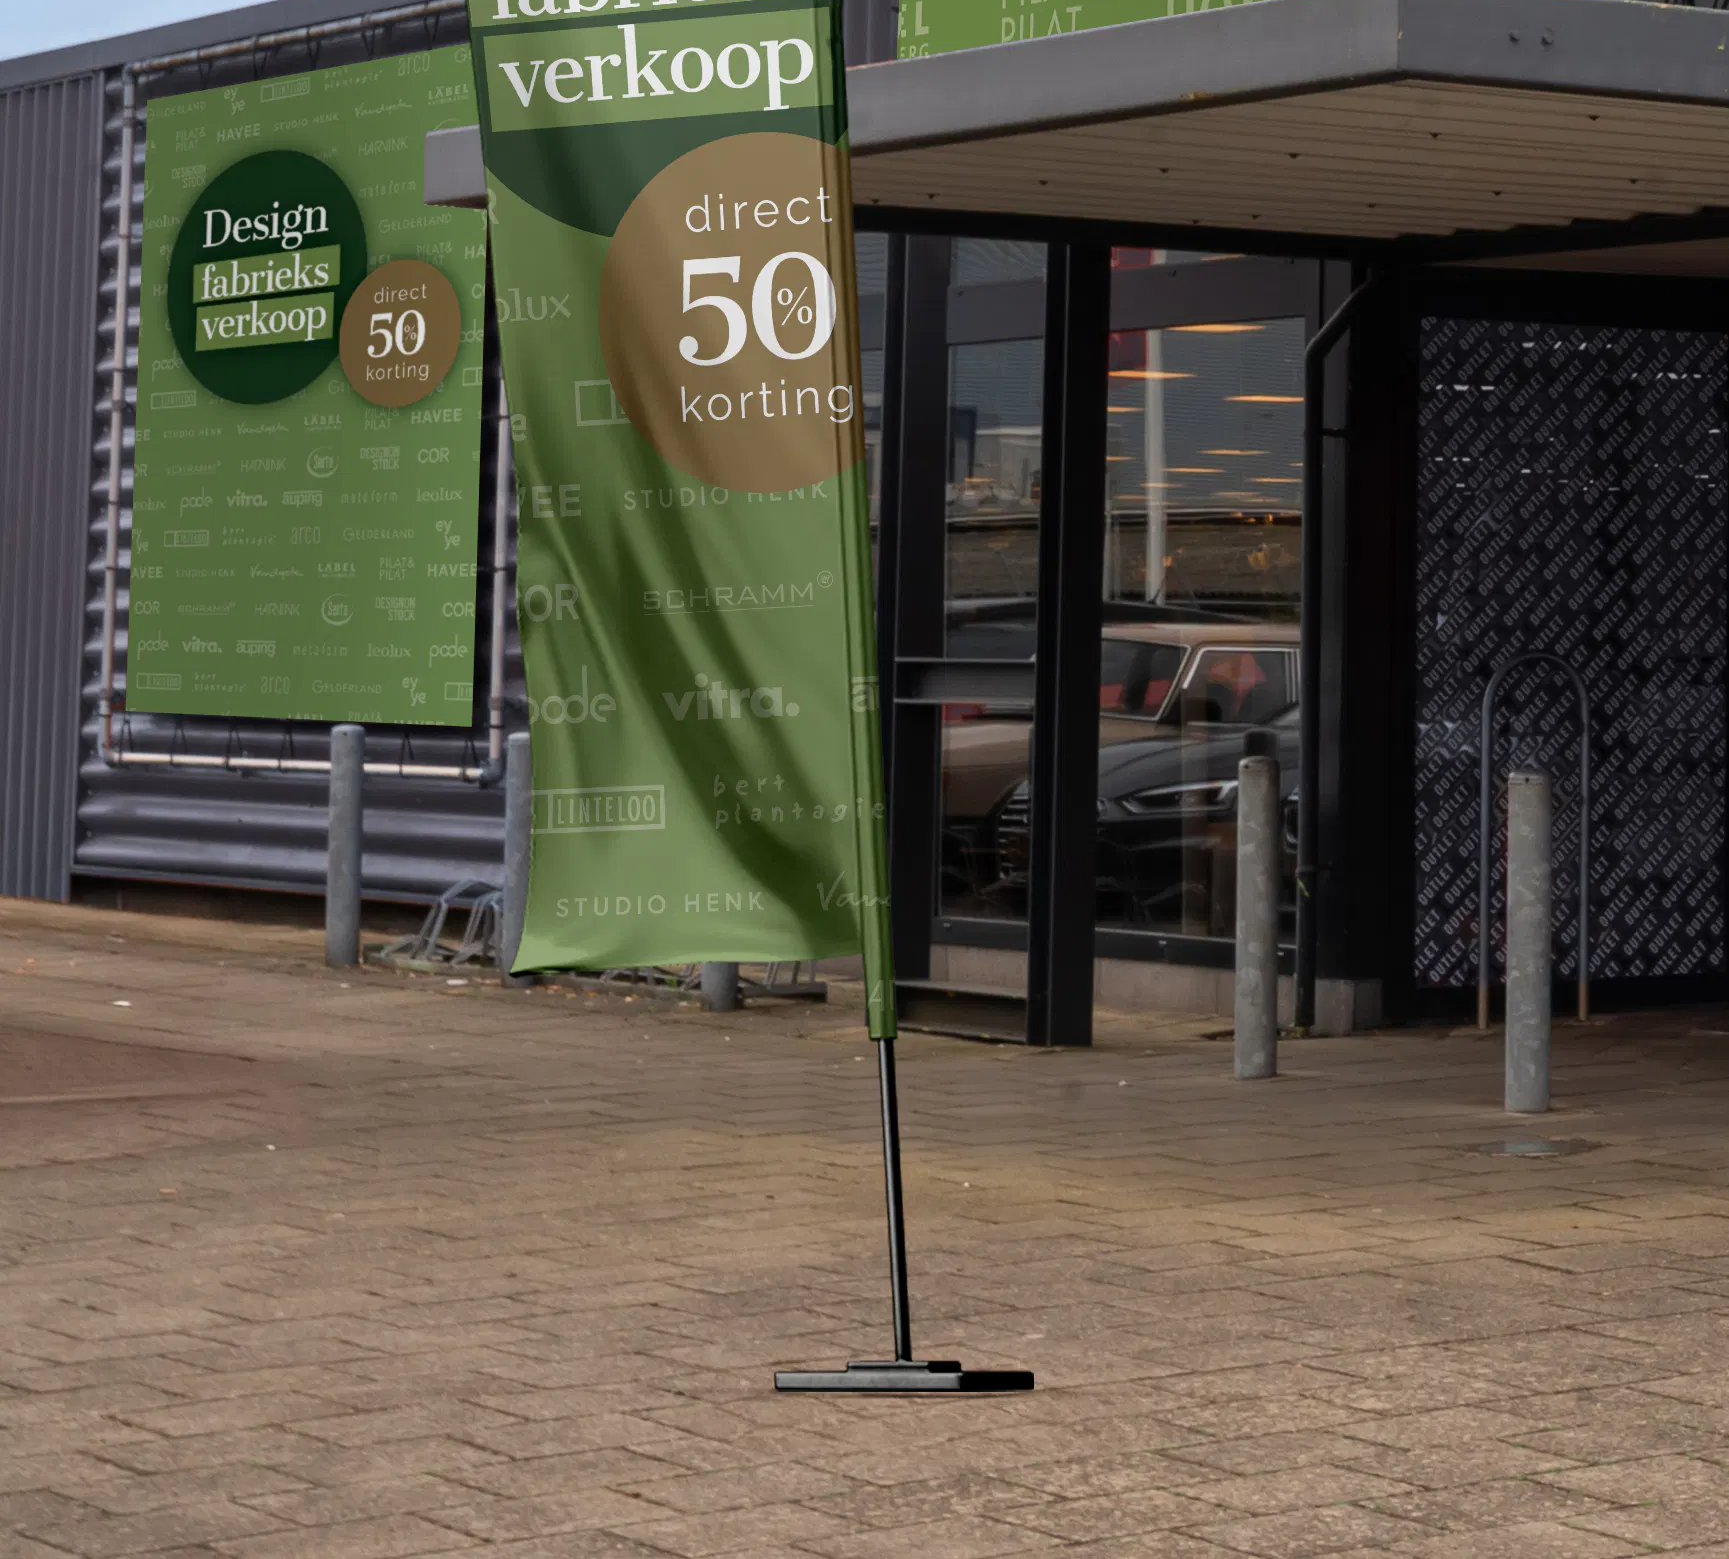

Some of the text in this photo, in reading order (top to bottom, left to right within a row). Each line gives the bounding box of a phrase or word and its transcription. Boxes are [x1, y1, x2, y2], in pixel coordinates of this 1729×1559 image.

[1001, 6, 1082, 44] PILAT
[499, 24, 814, 111] verkoop
[217, 124, 260, 142] HAVEE
[203, 201, 329, 250] Design
[686, 187, 832, 233] direct
[202, 253, 330, 300] fabrieks
[374, 284, 427, 303] direct
[201, 301, 327, 341] verkoop
[1422, 321, 1459, 360] OUTLET
[366, 362, 429, 381] korting
[411, 409, 462, 424] HAVEE
[682, 379, 854, 423] korting
[1572, 393, 1608, 429] OUTLET
[418, 448, 449, 463] COR
[417, 488, 462, 502] leolux
[624, 488, 729, 510] STUDIO
[428, 564, 477, 577] HAVEE
[643, 582, 814, 610] SCHRAMM
[367, 644, 411, 657] leolux
[713, 774, 785, 797] bert
[1433, 754, 1470, 796] OUTLET
[1651, 766, 1686, 805] OUTLET
[557, 794, 655, 826] LINTELOO
[1637, 839, 1671, 879] OUTLET
[557, 892, 764, 917] STUDIO HENK
[1623, 915, 1658, 955] OUTLET
